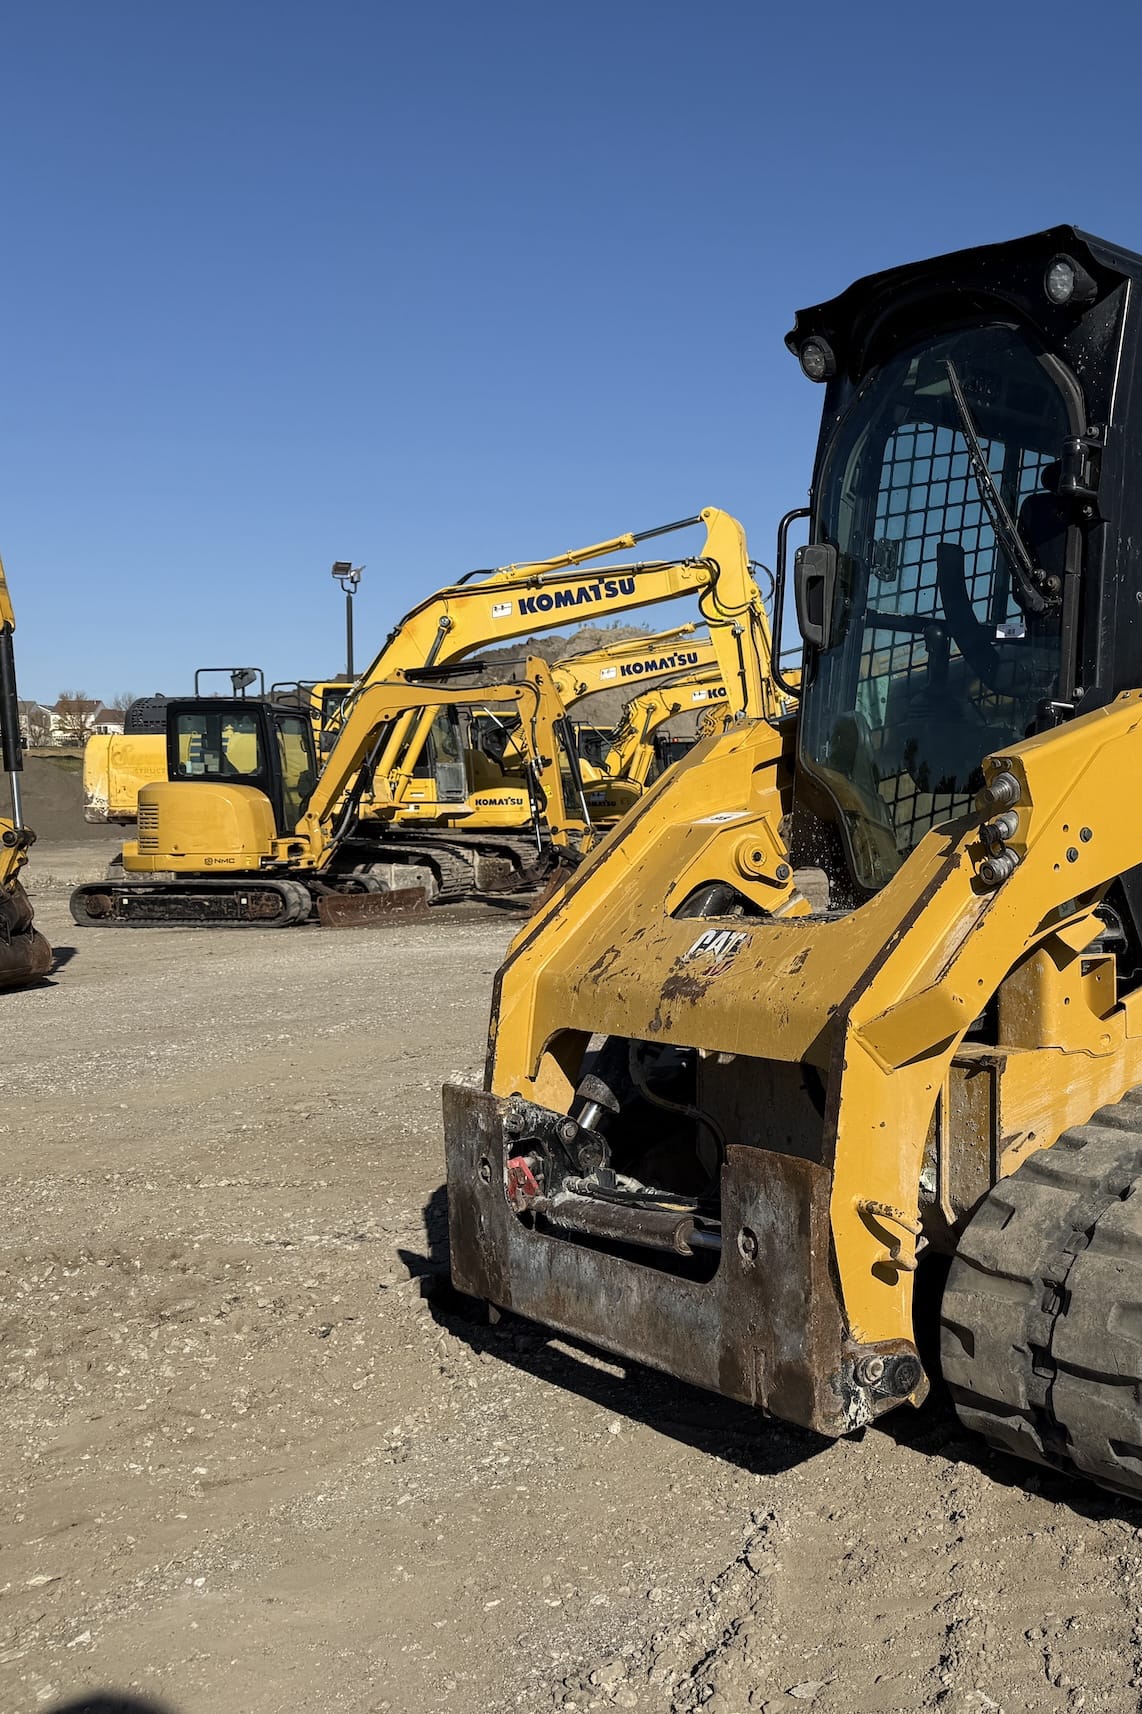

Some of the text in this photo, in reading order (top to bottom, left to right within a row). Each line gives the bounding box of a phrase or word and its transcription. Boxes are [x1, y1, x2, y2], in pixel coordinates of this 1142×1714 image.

[518, 577, 636, 615] KOMATSU
[620, 652, 698, 676] KOMATSU
[475, 796, 523, 806] KOMATSU
